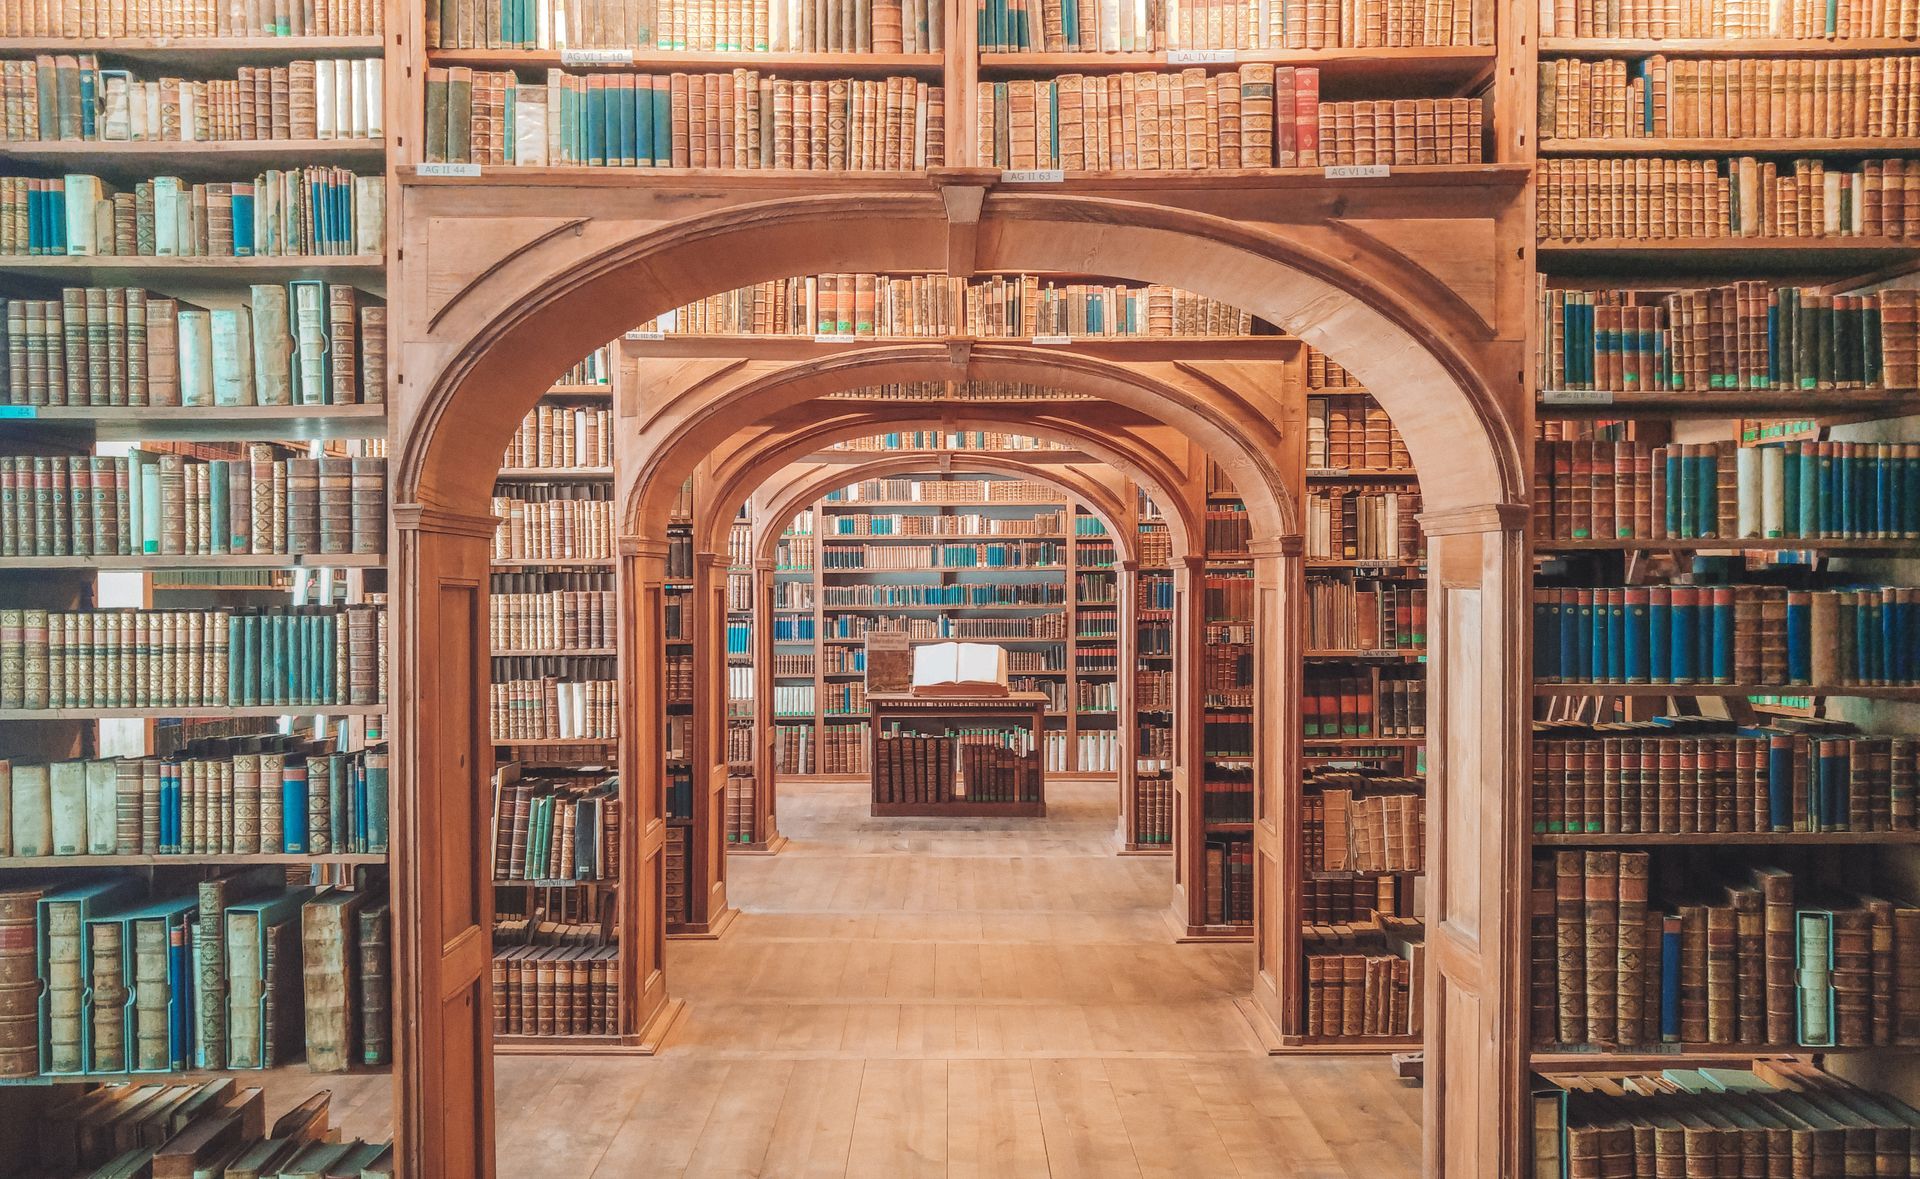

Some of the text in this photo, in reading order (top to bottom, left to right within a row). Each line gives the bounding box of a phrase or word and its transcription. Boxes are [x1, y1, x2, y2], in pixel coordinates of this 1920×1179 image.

[1177, 53, 1193, 61] LAL
[1198, 53, 1208, 61] IV
[453, 166, 465, 174] 44
[1331, 168, 1345, 176] AG
[1348, 167, 1359, 176] VI
[1364, 167, 1375, 175] 14
[1028, 172, 1035, 180] II
[1038, 172, 1051, 180] 63
